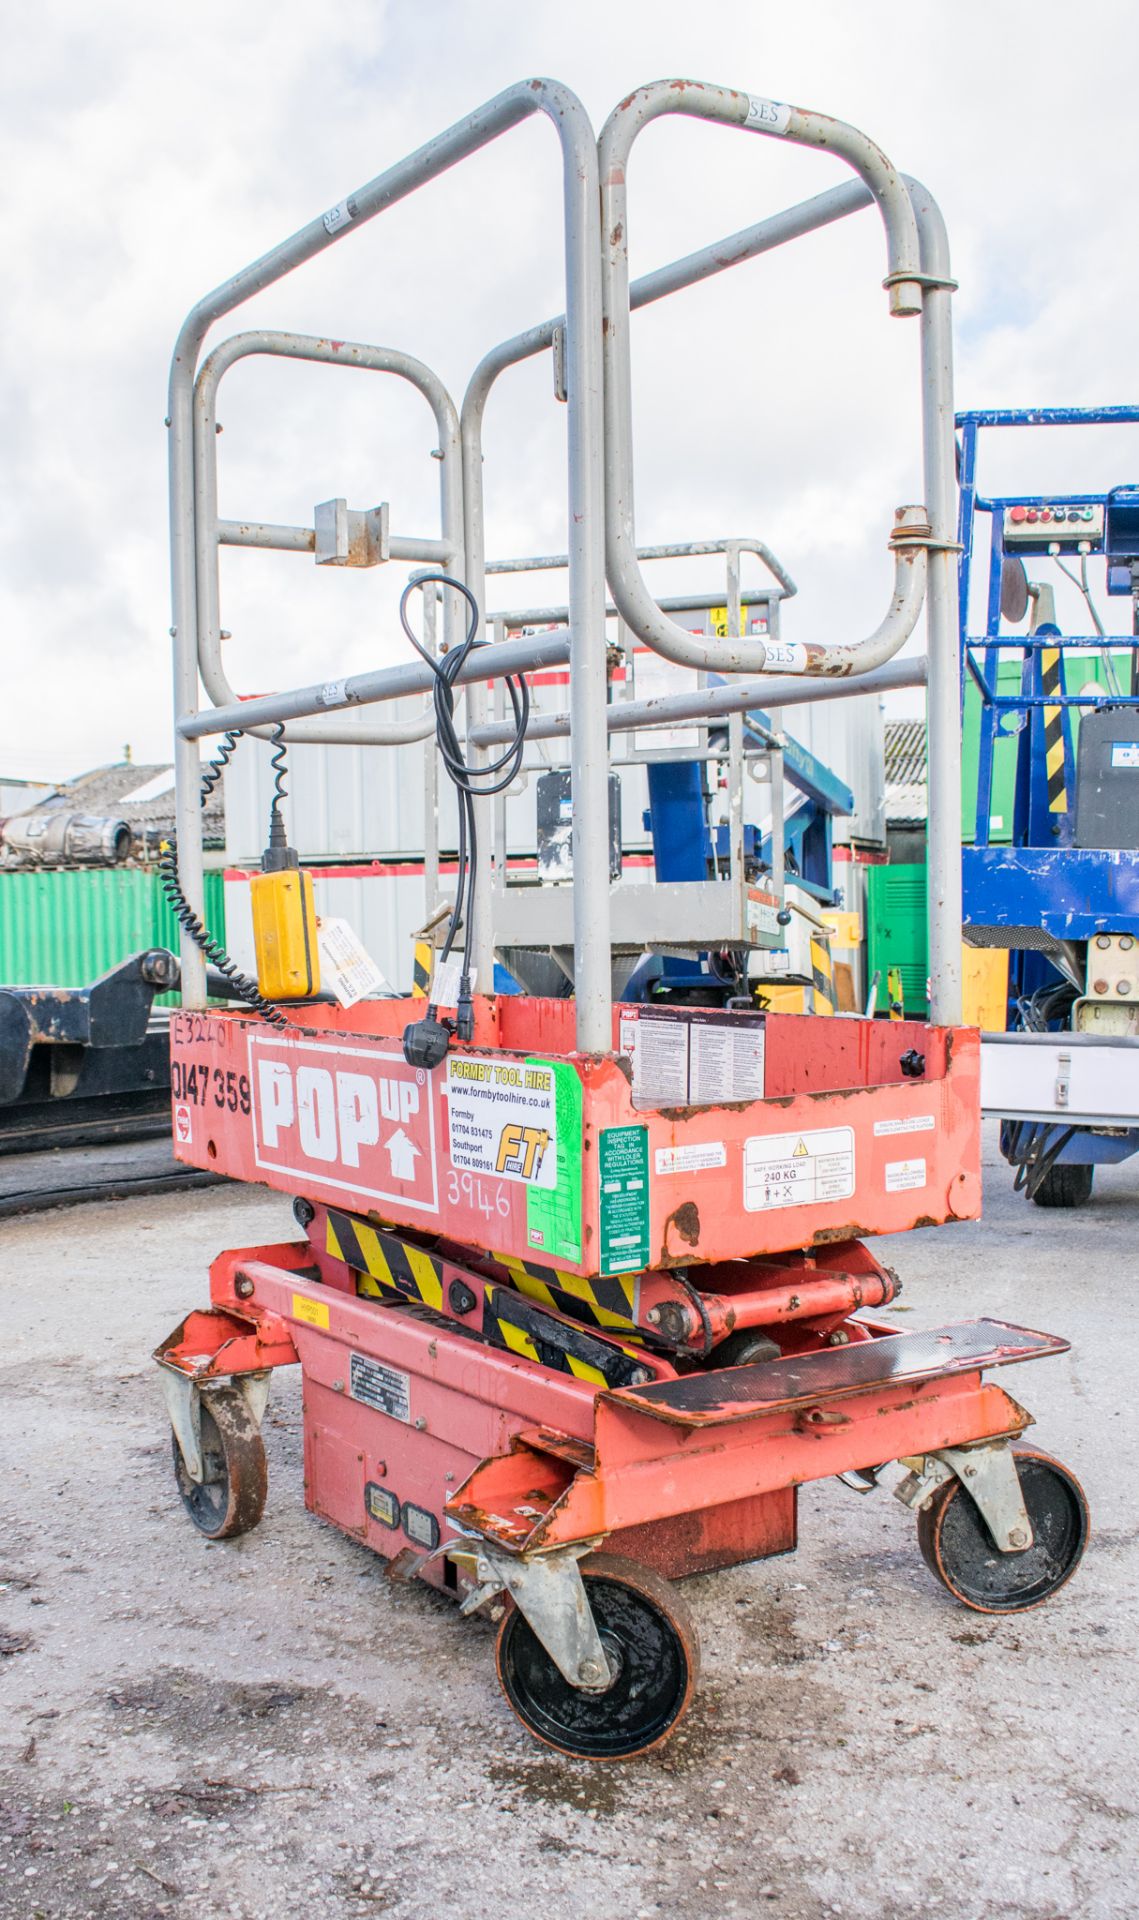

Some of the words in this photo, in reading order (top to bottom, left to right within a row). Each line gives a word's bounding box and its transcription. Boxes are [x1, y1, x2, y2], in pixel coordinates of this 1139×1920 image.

[749, 100, 778, 123] SES
[766, 646, 795, 663] SES
[450, 1060, 493, 1082] FORMBY
[494, 1066, 522, 1087] TOOL
[525, 1070, 551, 1091] HIRE
[213, 1068, 251, 1116] 359
[451, 1085, 551, 1109] www.formbytoolhire.co.uk
[257, 1059, 380, 1169] POP
[379, 1077, 420, 1124] UP
[451, 1107, 475, 1122] Formby
[452, 1123, 470, 1135] 01704
[471, 1126, 493, 1140] 831475
[607, 1130, 640, 1139] EQUIPMENT
[452, 1138, 483, 1154] Southport
[607, 1136, 641, 1145] INSPECTION
[453, 1154, 471, 1166] 01704
[604, 1147, 643, 1157] ACCORDANCE
[604, 1158, 644, 1168] REGULATIONS
[764, 1171, 781, 1183] 240
[783, 1169, 797, 1180] KG
[446, 1170, 511, 1220] 3946
